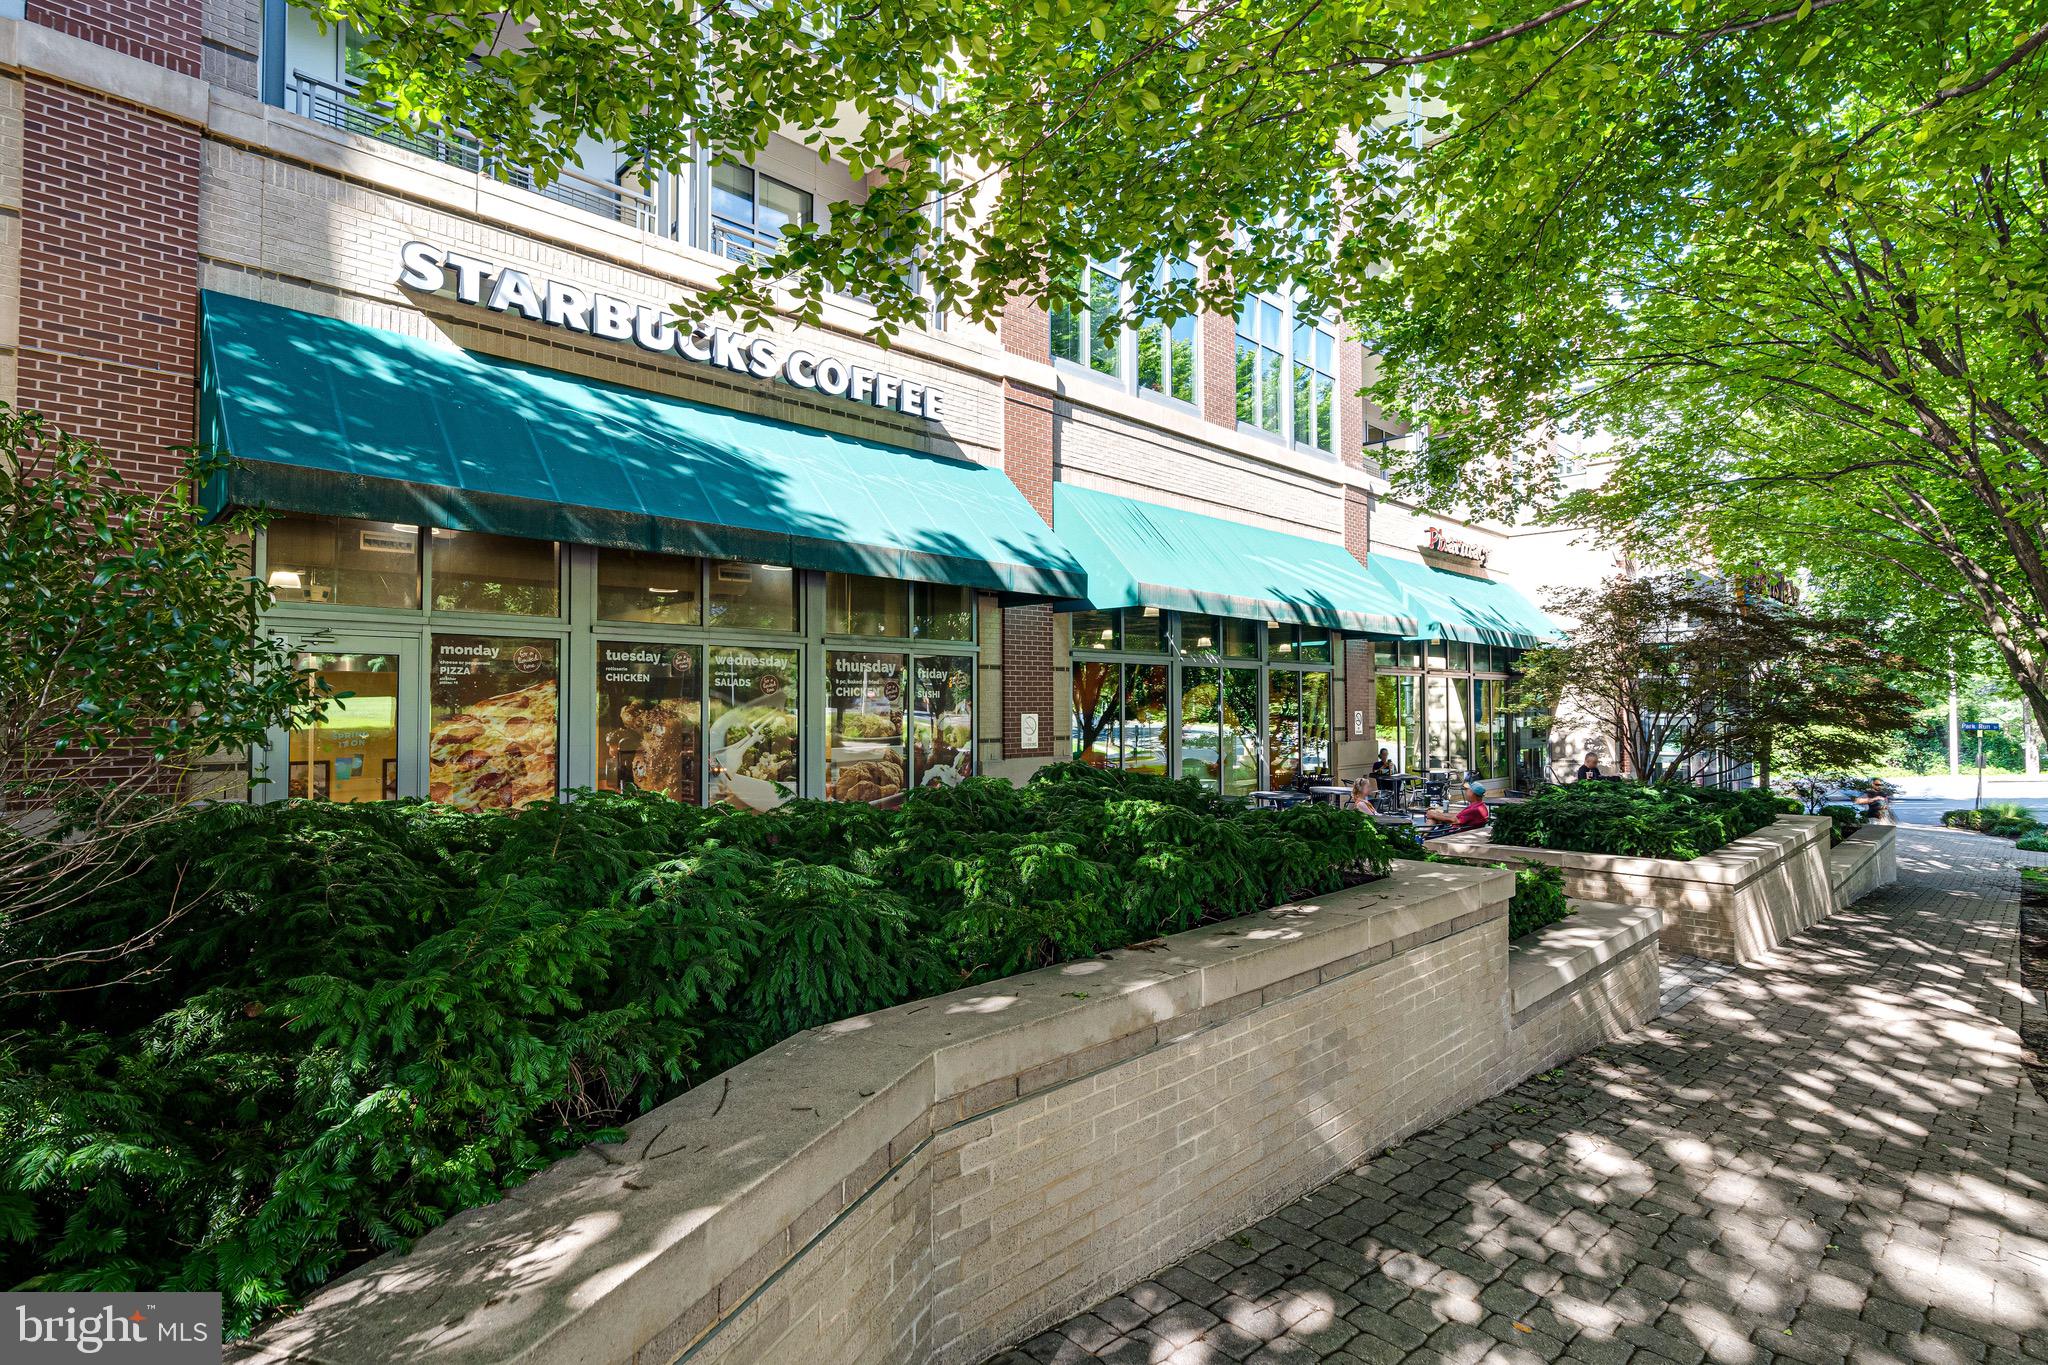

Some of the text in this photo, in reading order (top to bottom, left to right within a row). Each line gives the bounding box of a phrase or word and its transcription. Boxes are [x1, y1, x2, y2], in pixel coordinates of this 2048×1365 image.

[401, 240, 945, 420] STARBUCKS COFFEE
[440, 644, 500, 659] monday
[605, 649, 661, 666] tuesday
[715, 654, 788, 670] wednesday
[835, 658, 896, 677] thursday
[440, 666, 471, 675] PIZZA
[605, 673, 650, 682] CHICKEN
[917, 667, 948, 682] friday
[714, 678, 751, 687] SALADS
[835, 687, 880, 697] CHICKEN
[917, 690, 940, 699] SUSHI
